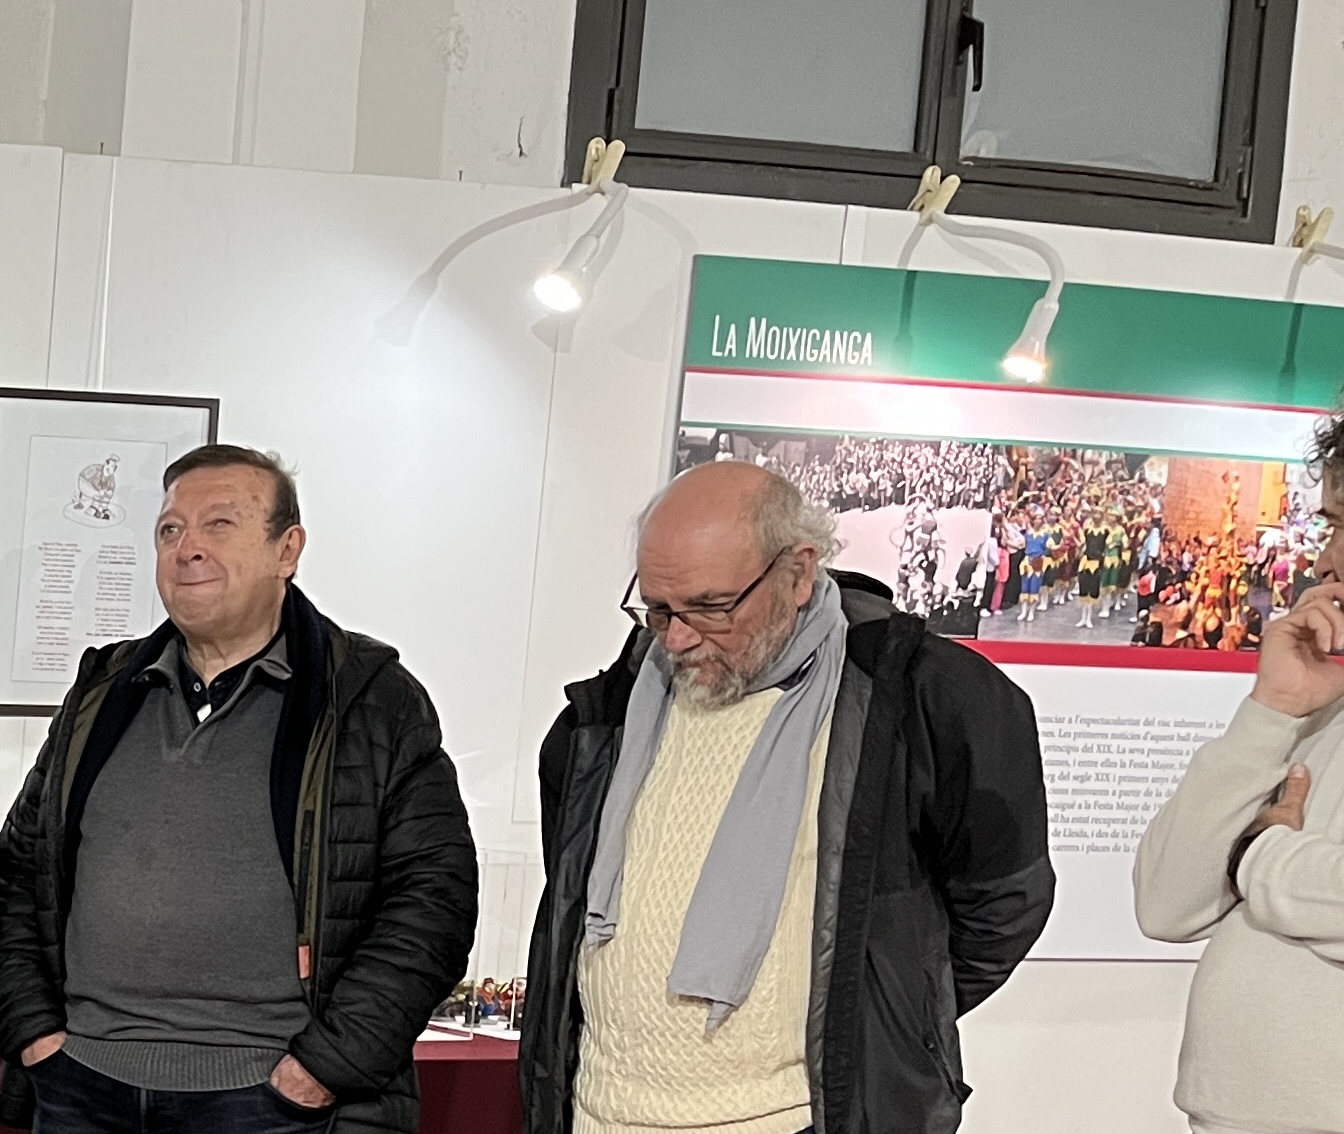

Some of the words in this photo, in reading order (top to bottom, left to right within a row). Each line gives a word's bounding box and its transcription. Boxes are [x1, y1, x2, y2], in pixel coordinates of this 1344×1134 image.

[1116, 744, 1126, 754] La
[1084, 800, 1091, 810] la
[1051, 827, 1061, 837] de
